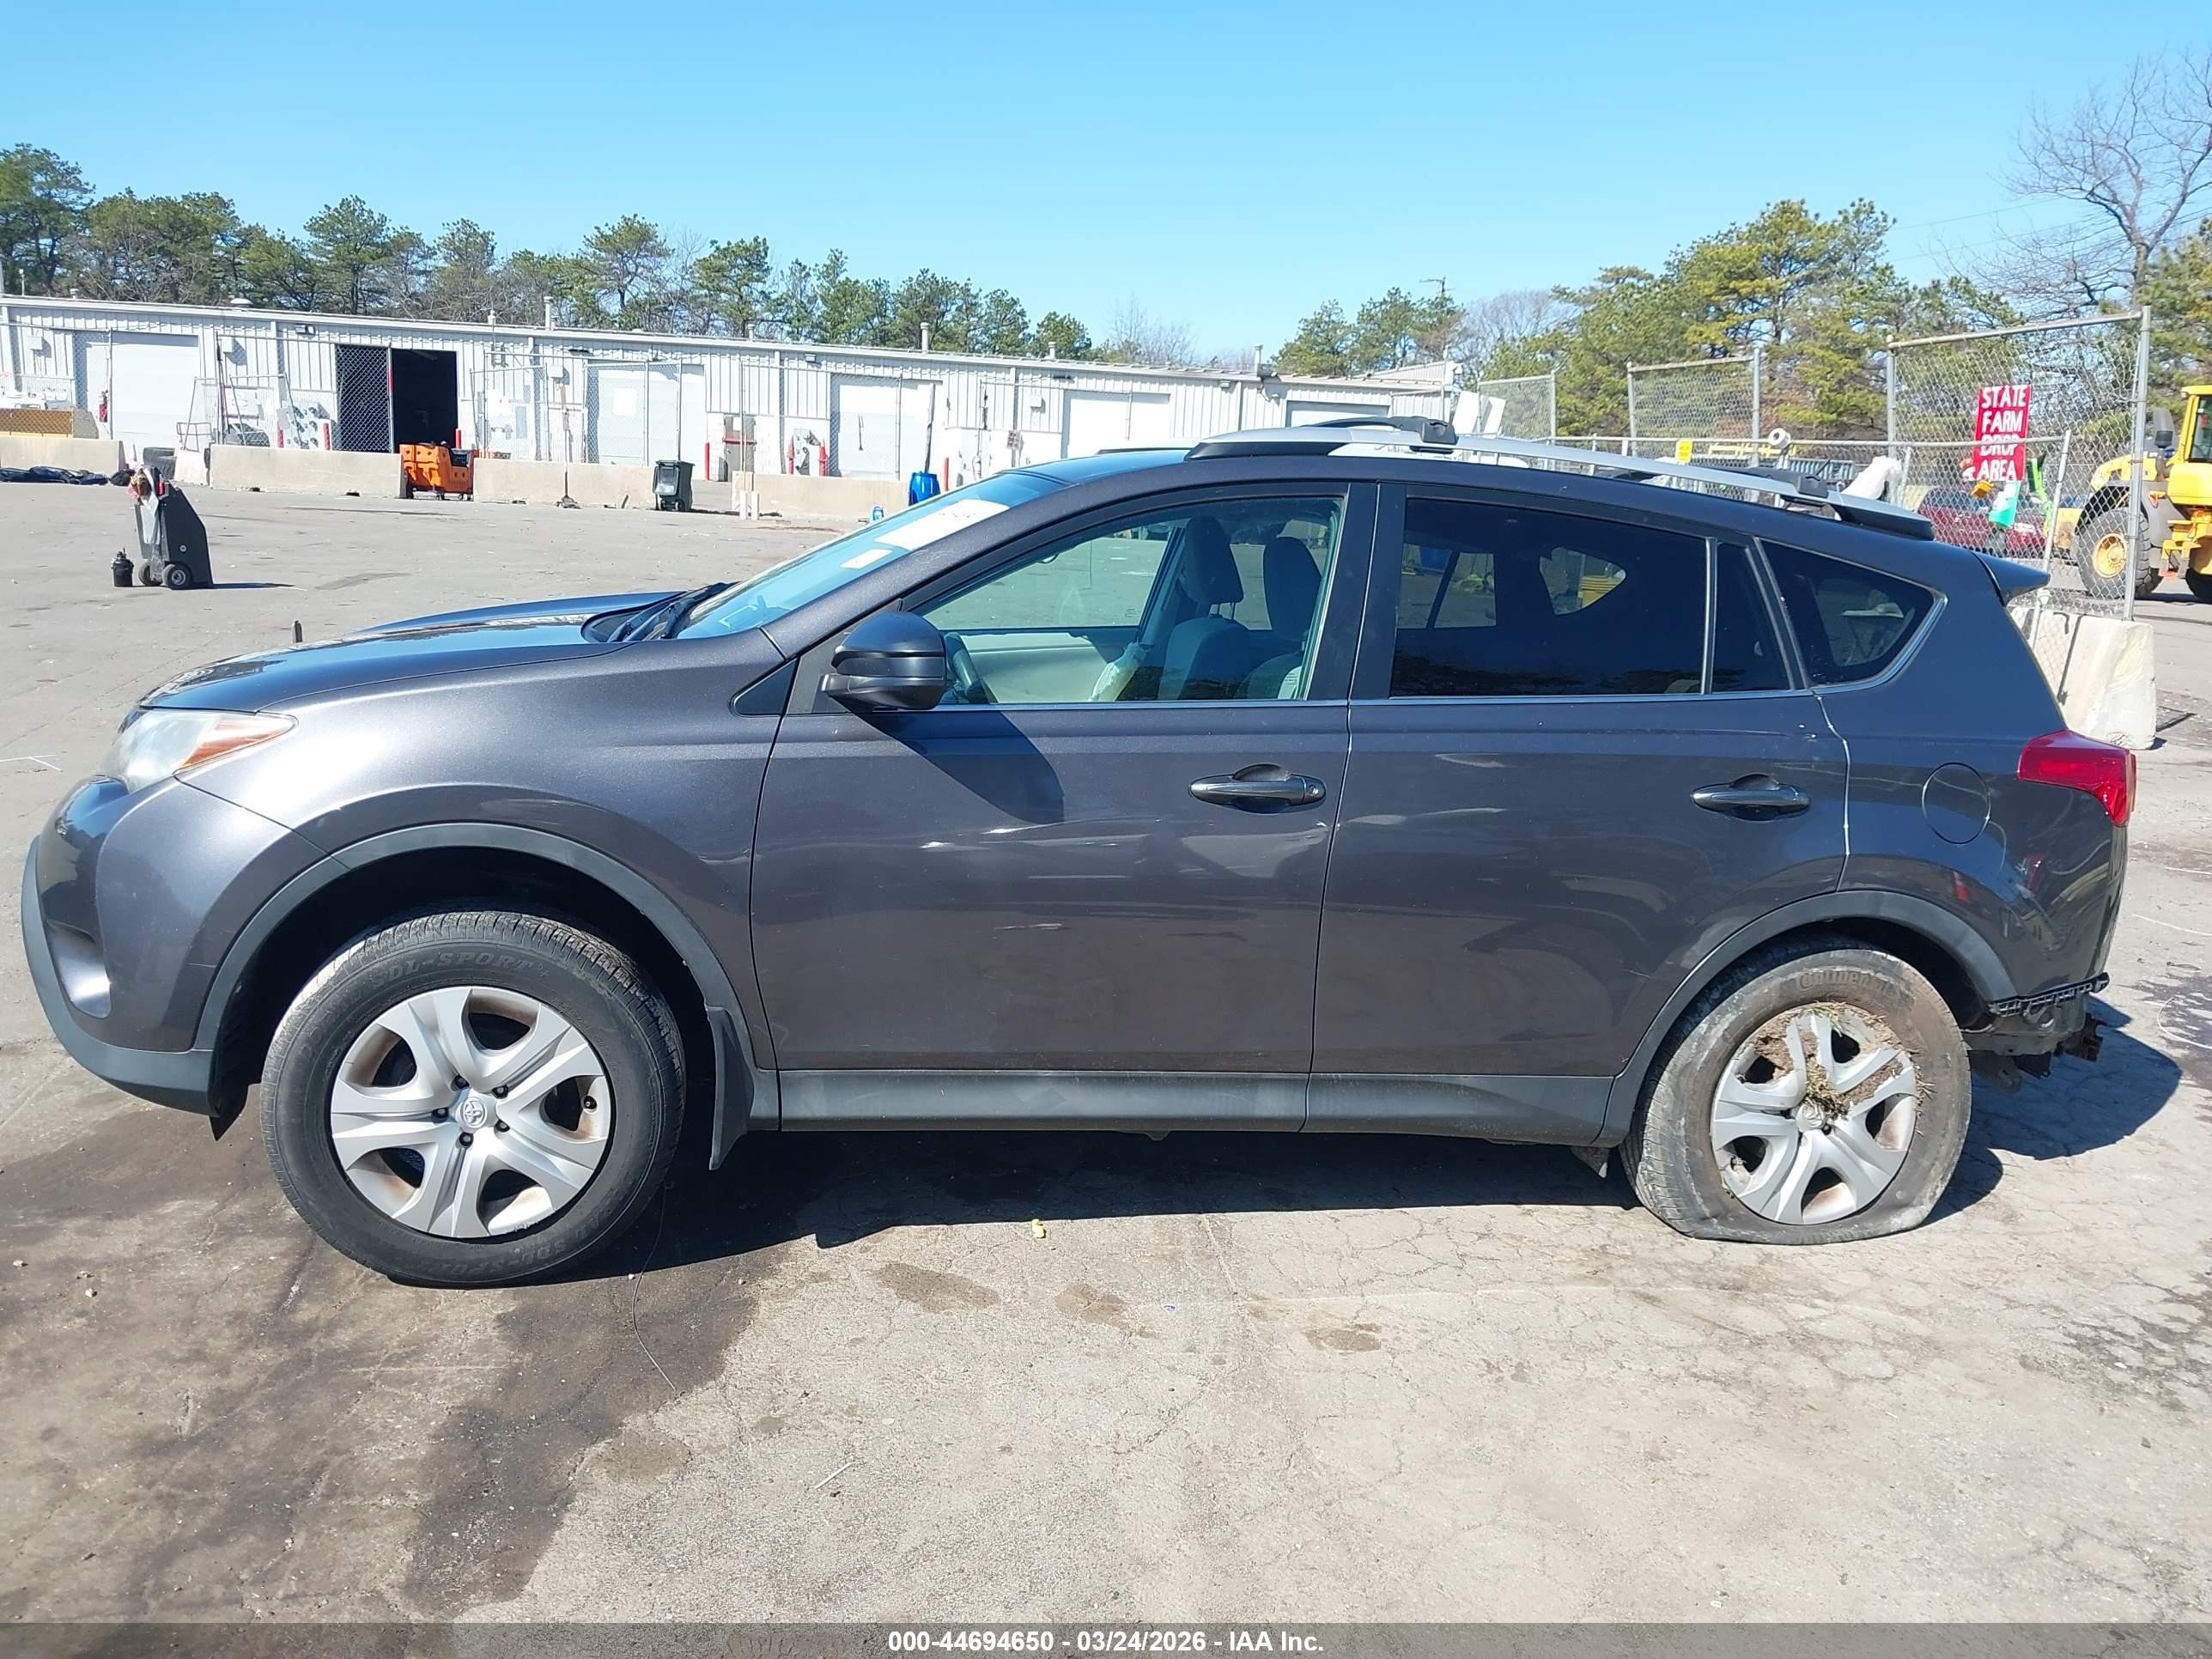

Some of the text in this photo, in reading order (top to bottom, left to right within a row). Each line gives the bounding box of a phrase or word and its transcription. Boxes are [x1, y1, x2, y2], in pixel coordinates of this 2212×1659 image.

[1981, 386, 2027, 409] STATE
[1981, 410, 2023, 433] FARM
[1979, 434, 2020, 456] DROP
[1977, 459, 2017, 481] AREA
[1799, 969, 1893, 995] Continenal
